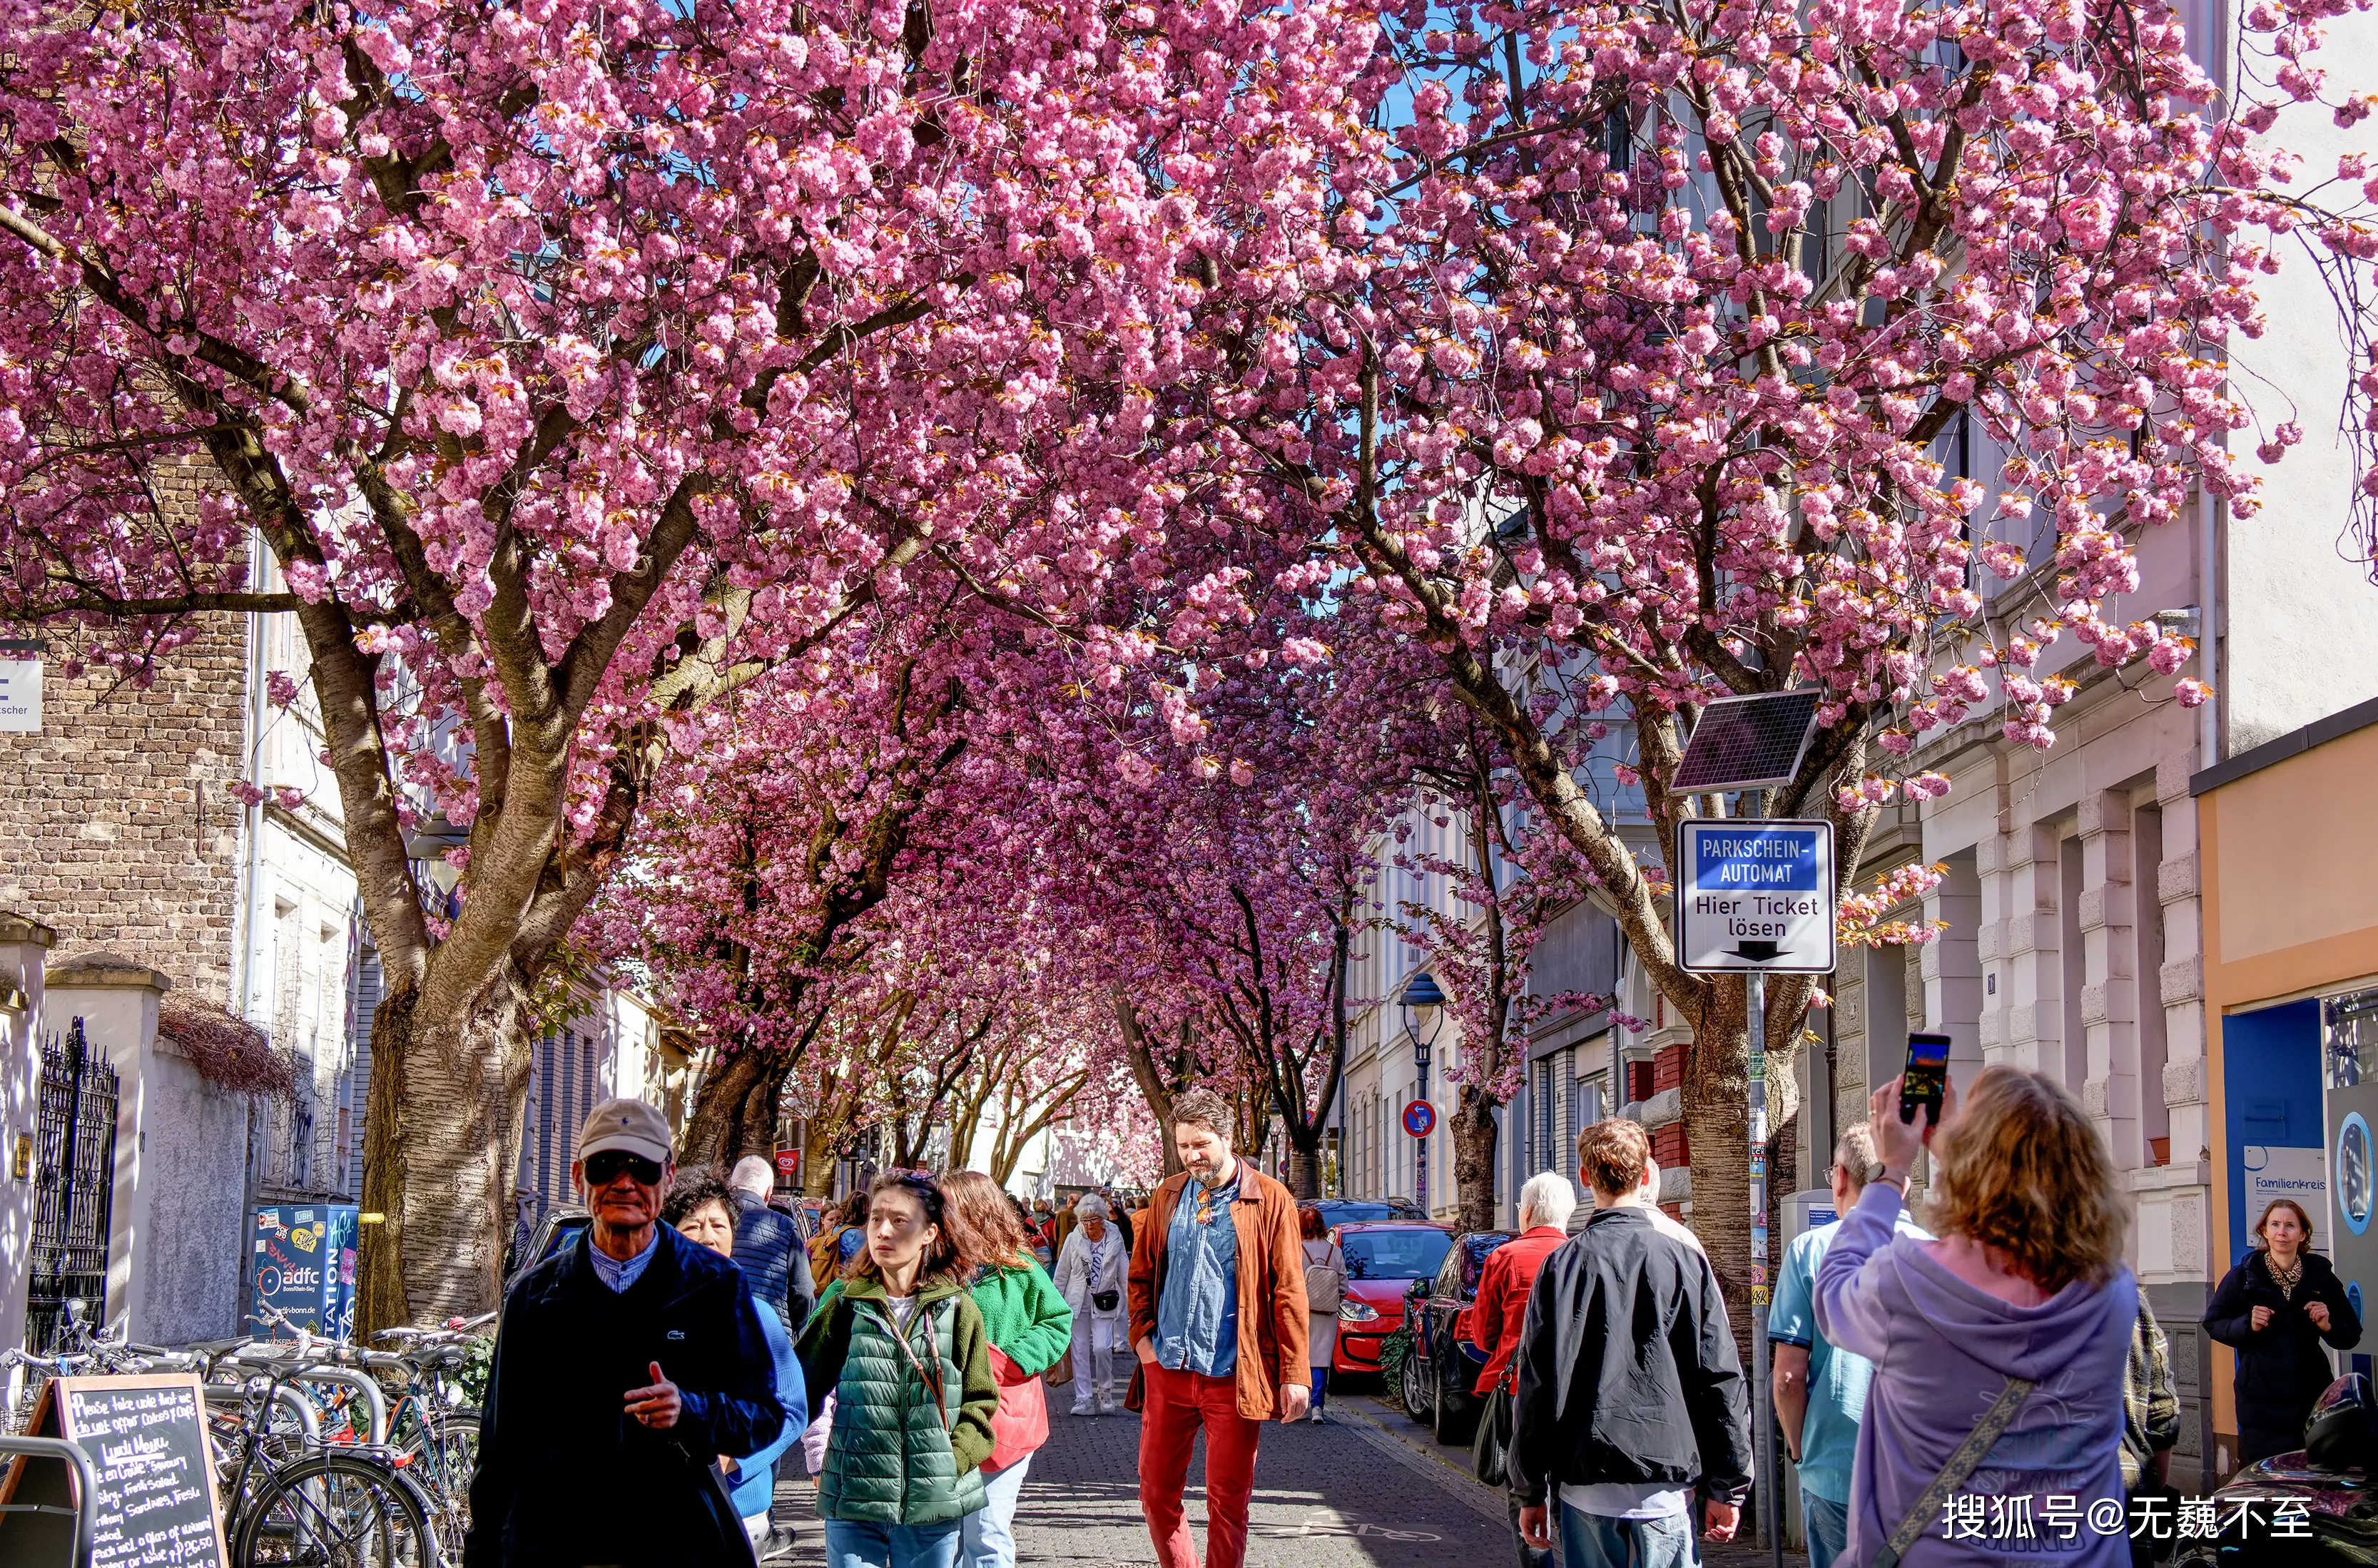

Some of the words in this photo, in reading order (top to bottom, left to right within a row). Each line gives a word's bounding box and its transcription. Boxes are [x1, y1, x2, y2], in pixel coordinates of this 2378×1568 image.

[1702, 839, 1809, 858] PARKSCHEIN-
[1720, 864, 1793, 882] AUTOMAT
[1696, 896, 1742, 915] Hier
[1753, 897, 1818, 915] Ticket
[1729, 918, 1786, 937] lösen
[2255, 1177, 2326, 1190] Familienkreis
[275, 1230, 287, 1240] AFD
[277, 1225, 288, 1235] FCK
[283, 1267, 320, 1285] adfc
[325, 1248, 338, 1336] TATION
[71, 1392, 110, 1418] Please
[112, 1395, 136, 1411] take
[74, 1419, 91, 1436] do
[133, 1433, 168, 1454] Menu
[168, 1524, 180, 1542] of
